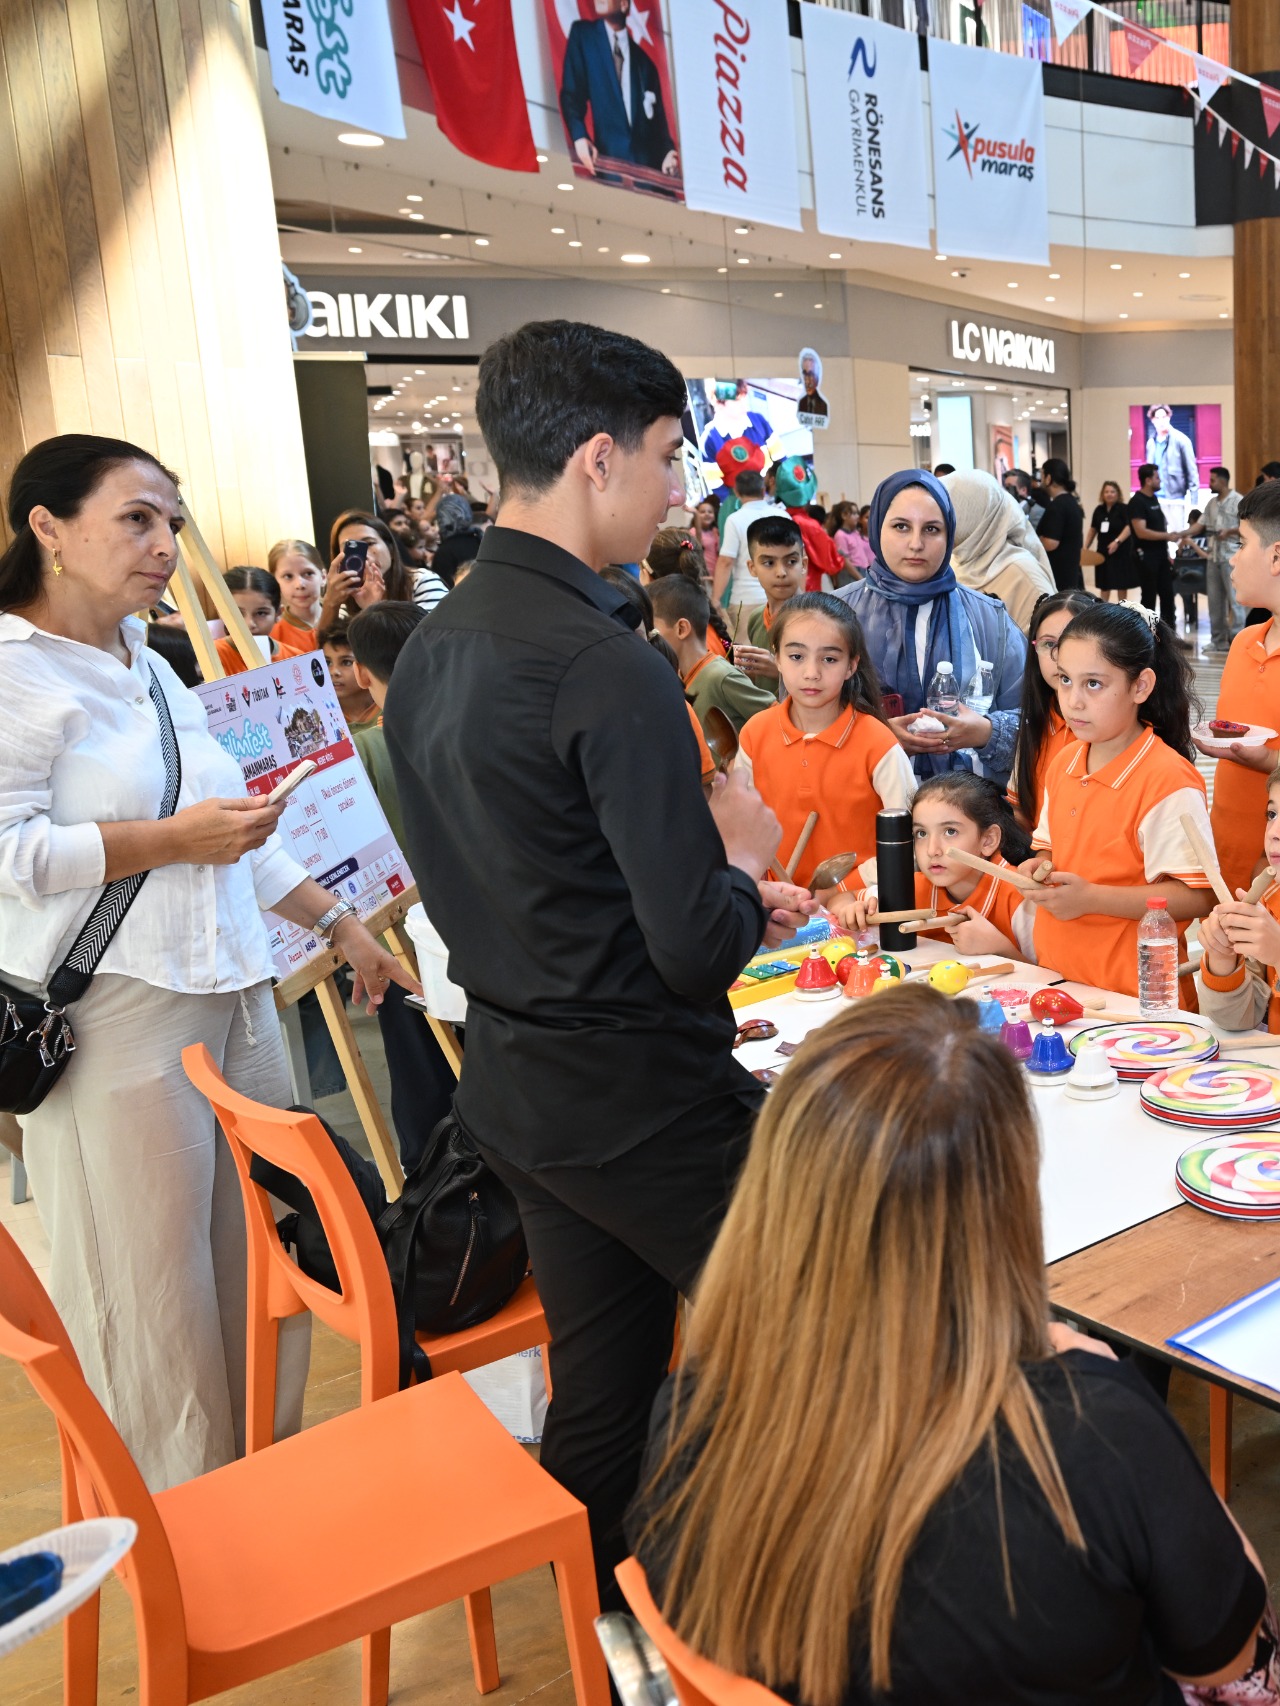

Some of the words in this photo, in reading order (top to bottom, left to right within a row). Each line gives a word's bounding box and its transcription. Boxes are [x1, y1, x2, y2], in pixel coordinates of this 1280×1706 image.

[712, 0, 751, 193] Piazza
[848, 89, 867, 217] GAYRİMENKUL
[864, 92, 885, 219] RÖNESANS
[972, 136, 1035, 163] pusula
[981, 157, 1035, 182] maraş
[951, 320, 981, 362] LC
[242, 754, 277, 781] AMANMARAŞ
